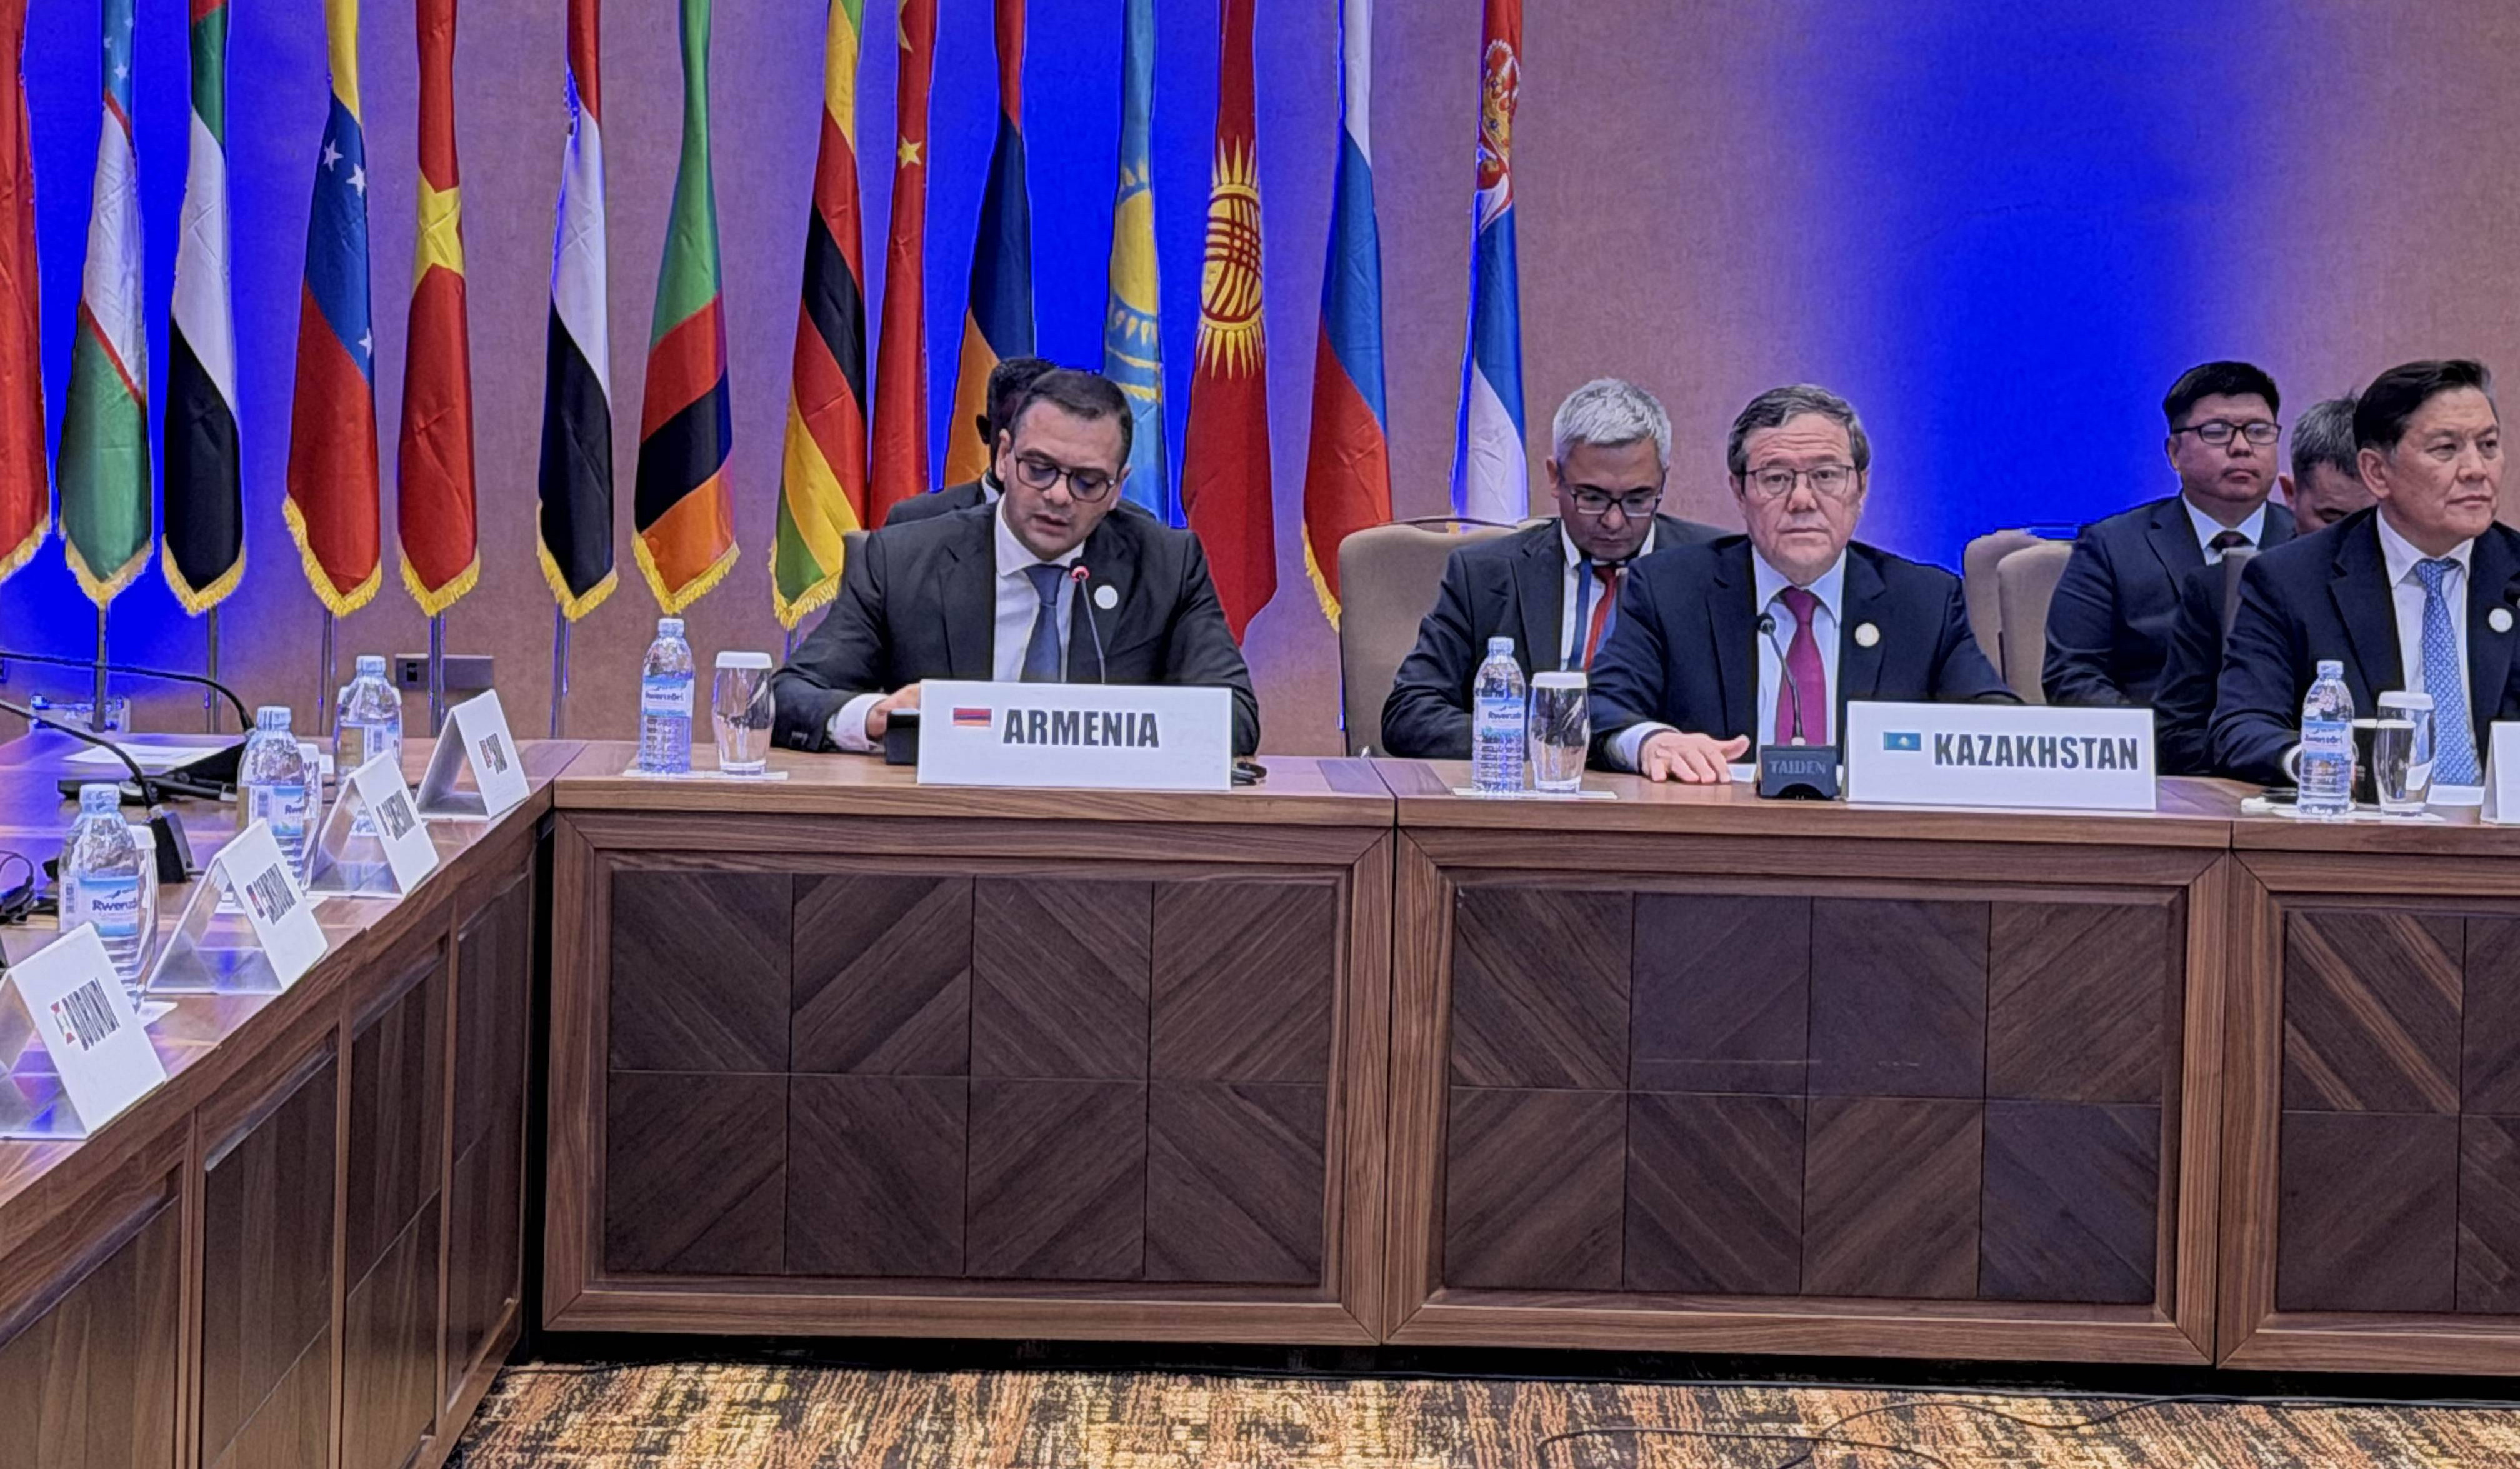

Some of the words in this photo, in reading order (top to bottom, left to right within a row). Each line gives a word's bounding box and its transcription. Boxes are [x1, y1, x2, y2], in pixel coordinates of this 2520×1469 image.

[1002, 708, 1159, 748] ARMENIA
[1769, 760, 1826, 775] TAIDEN
[1934, 733, 2139, 770] KAZAKHSTAN
